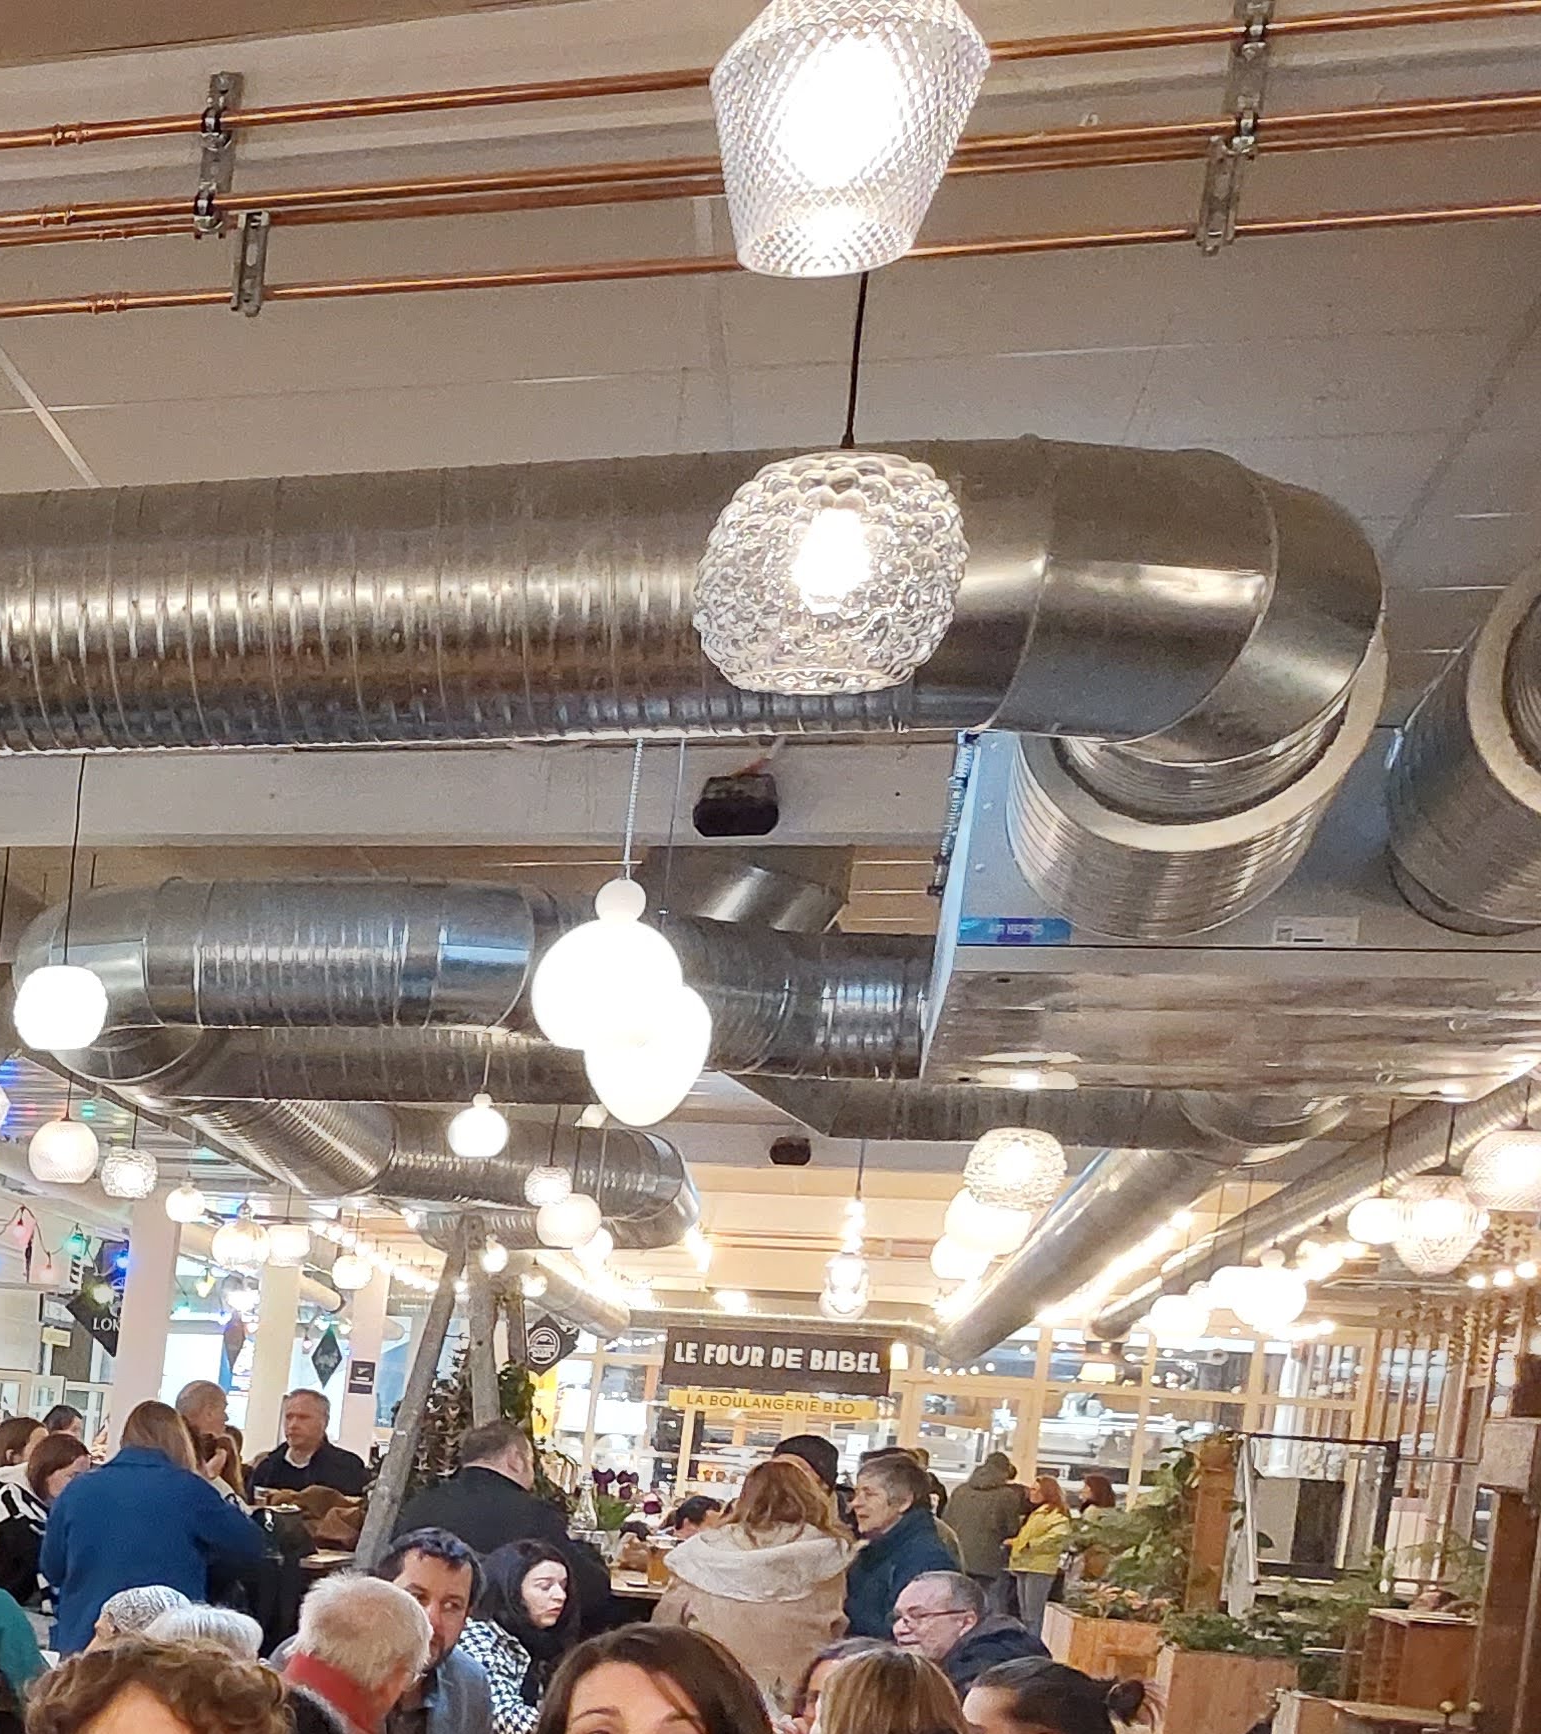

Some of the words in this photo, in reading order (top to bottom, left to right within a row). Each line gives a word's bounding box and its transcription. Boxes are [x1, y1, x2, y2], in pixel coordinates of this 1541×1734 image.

[92, 1318, 120, 1332] LOK
[673, 1341, 699, 1364] LE
[703, 1343, 765, 1367] FOUR
[770, 1347, 804, 1370] DE
[809, 1349, 881, 1374] BABEL
[686, 1393, 705, 1405] LA
[709, 1394, 818, 1413] BOULANGERIE
[823, 1402, 856, 1415] BIO
